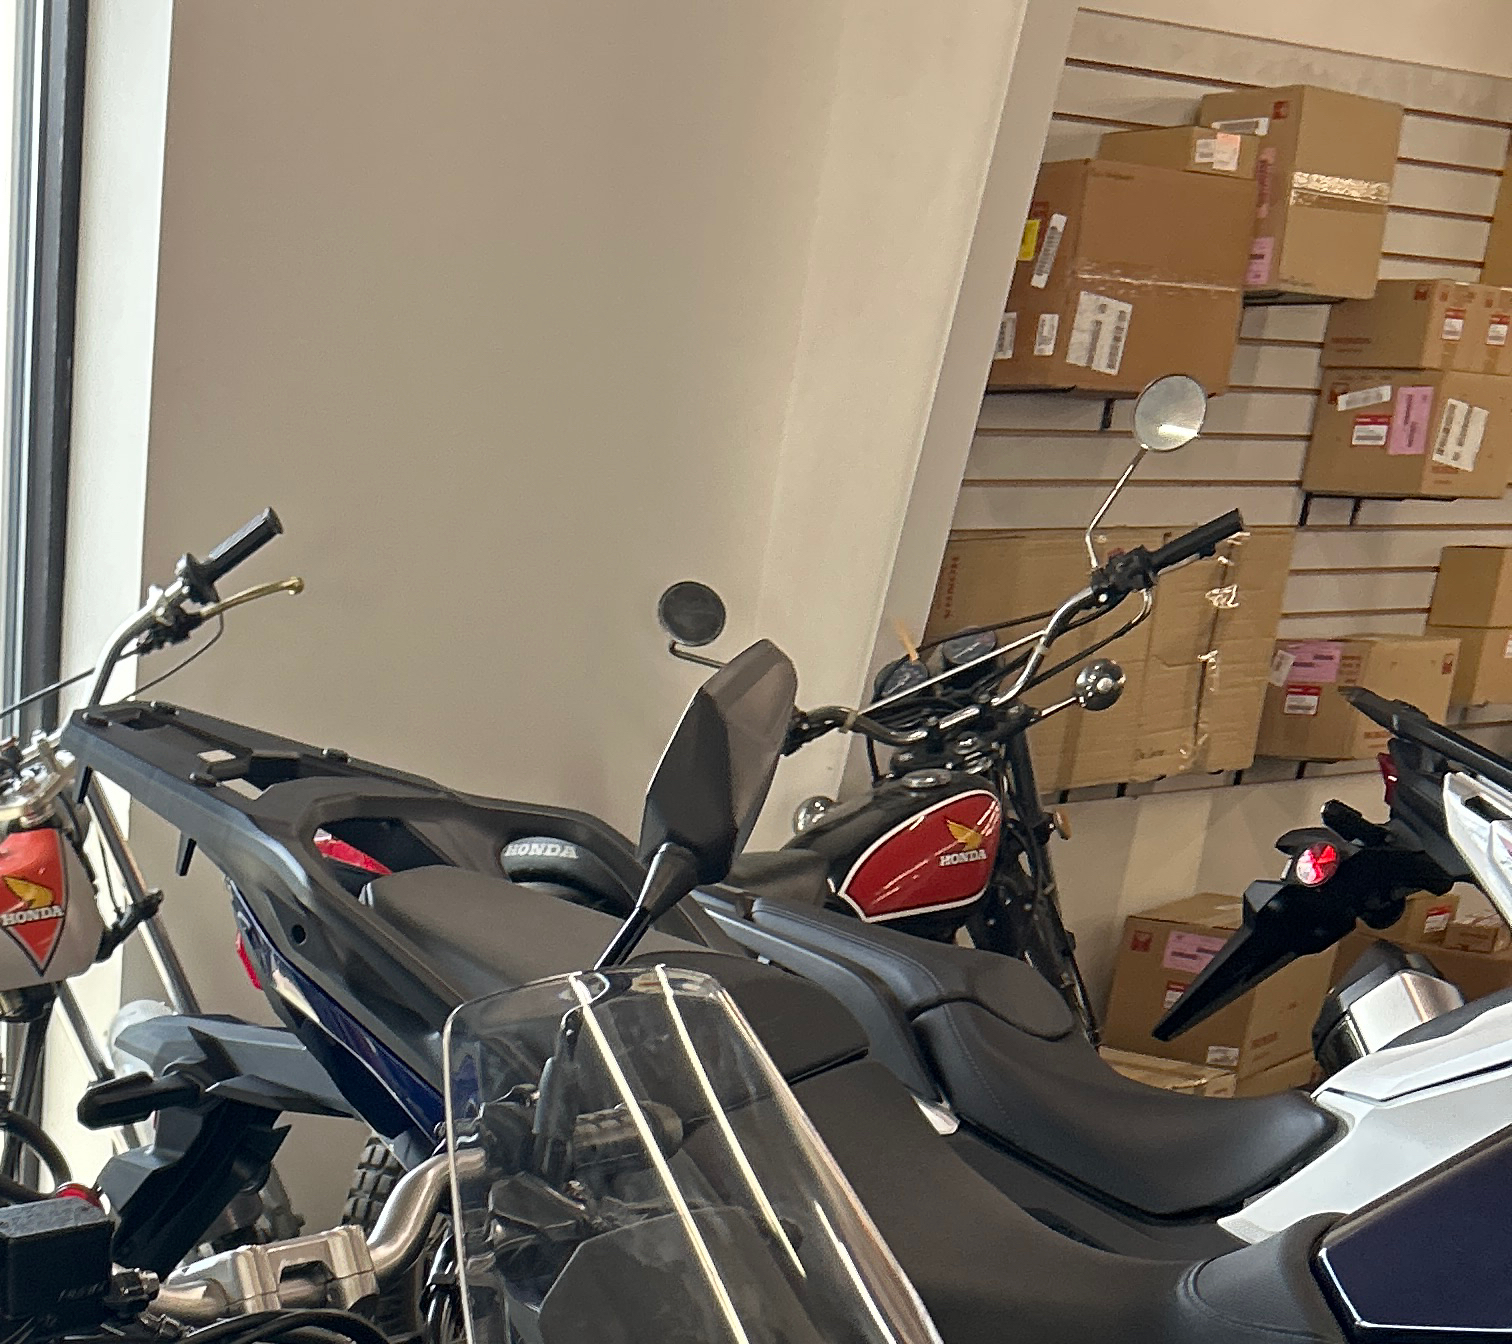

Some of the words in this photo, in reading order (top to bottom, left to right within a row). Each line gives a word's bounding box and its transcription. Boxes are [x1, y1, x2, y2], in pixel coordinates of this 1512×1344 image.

[504, 843, 579, 859] HONDA
[939, 848, 987, 867] HONDA
[1, 905, 65, 926] HONDA
